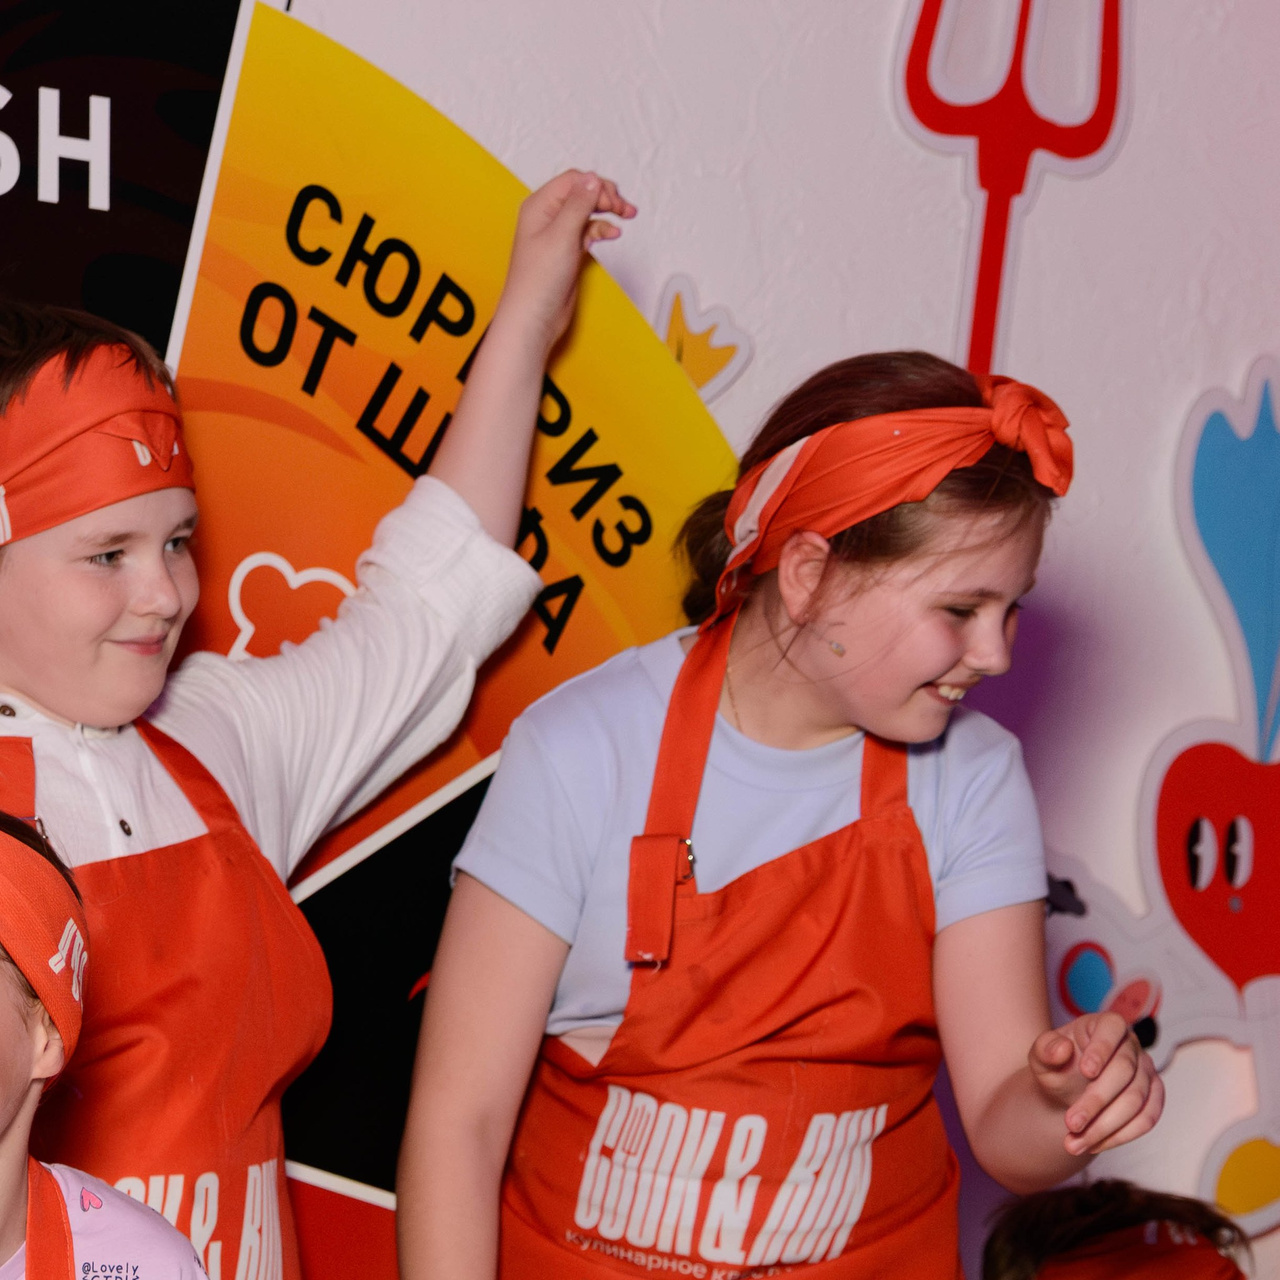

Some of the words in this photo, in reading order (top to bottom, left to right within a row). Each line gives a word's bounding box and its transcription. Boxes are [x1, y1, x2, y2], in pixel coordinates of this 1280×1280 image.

[239, 282, 357, 398] ОТ
[355, 361, 585, 656] ША
[285, 183, 652, 569] СЮРРИЗ
[82, 1262, 139, 1275] @Lovely
[574, 1084, 726, 1256] COOK
[698, 1114, 768, 1265] &
